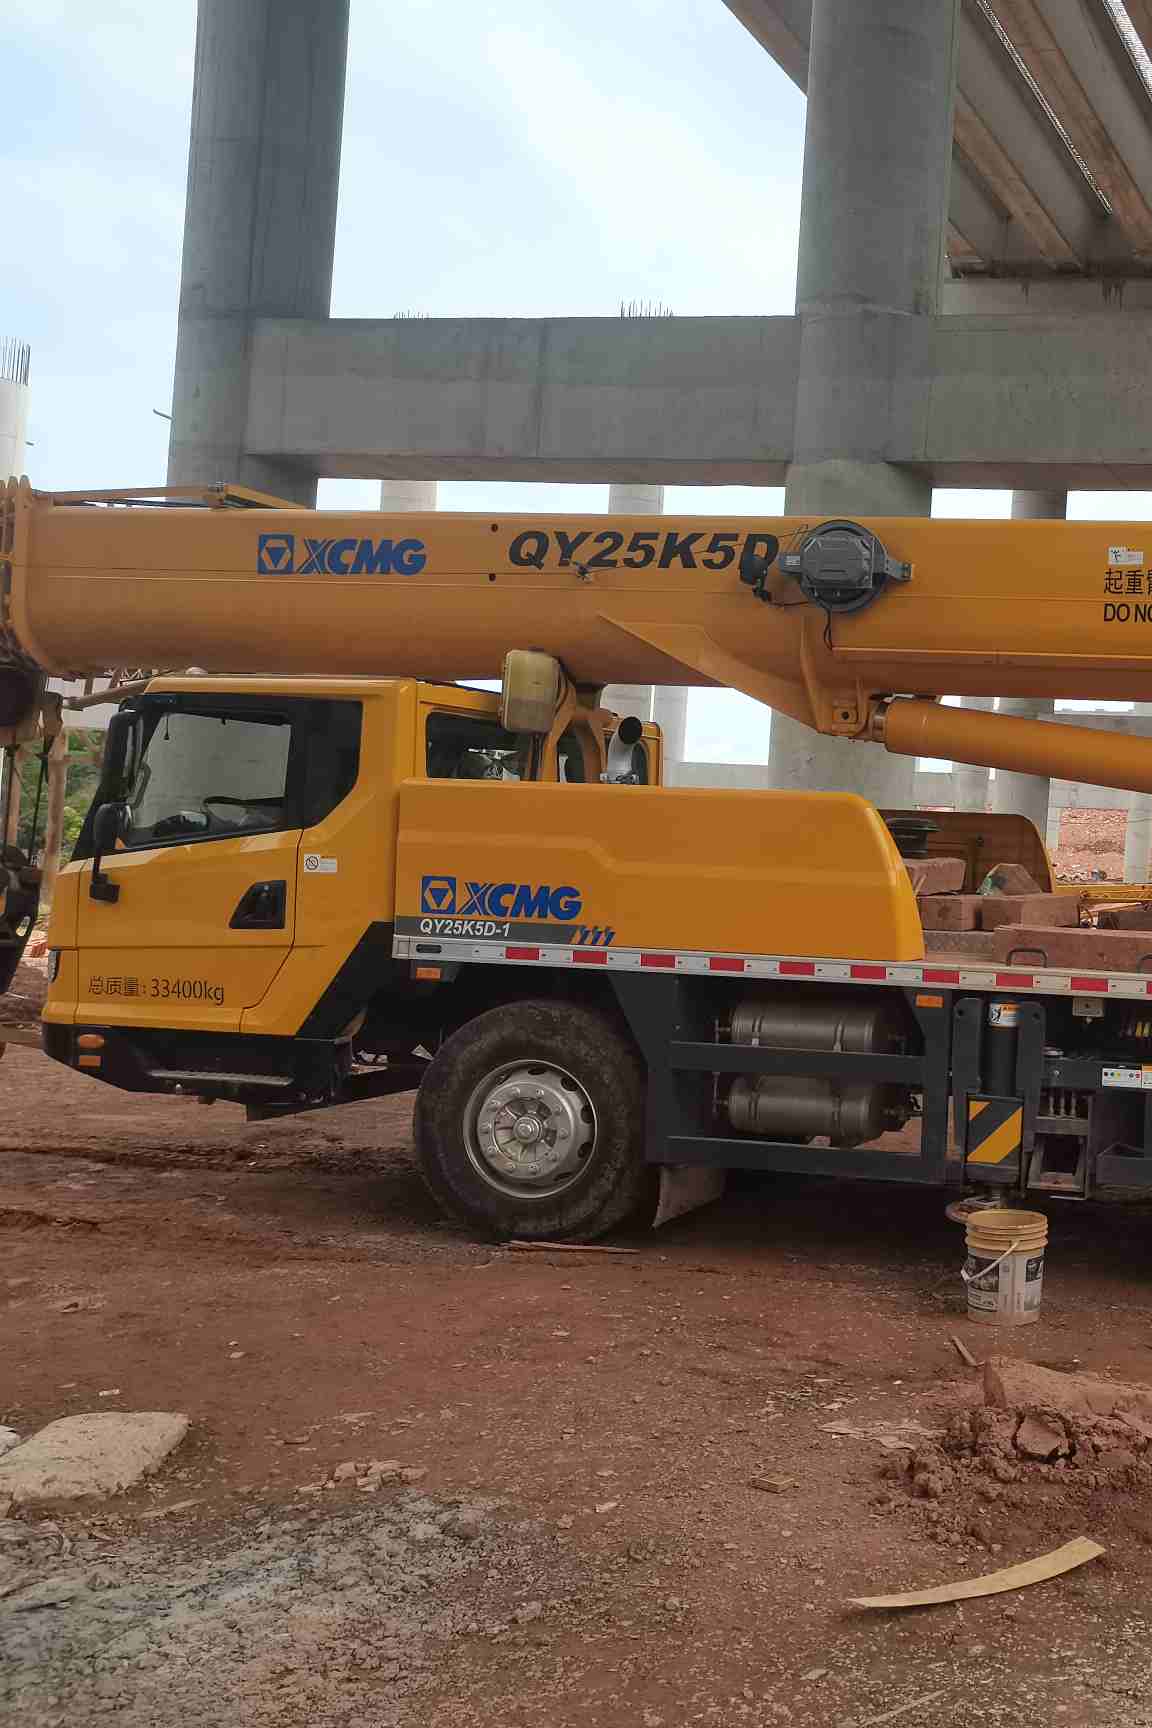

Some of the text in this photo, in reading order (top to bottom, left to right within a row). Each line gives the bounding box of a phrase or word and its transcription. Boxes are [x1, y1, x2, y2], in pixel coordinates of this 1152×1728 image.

[297, 537, 426, 575] XCMG
[509, 530, 780, 574] QY25K5D
[1104, 602, 1130, 622] DO
[456, 881, 583, 920] XCMG
[419, 917, 511, 937] QY25K5D-1
